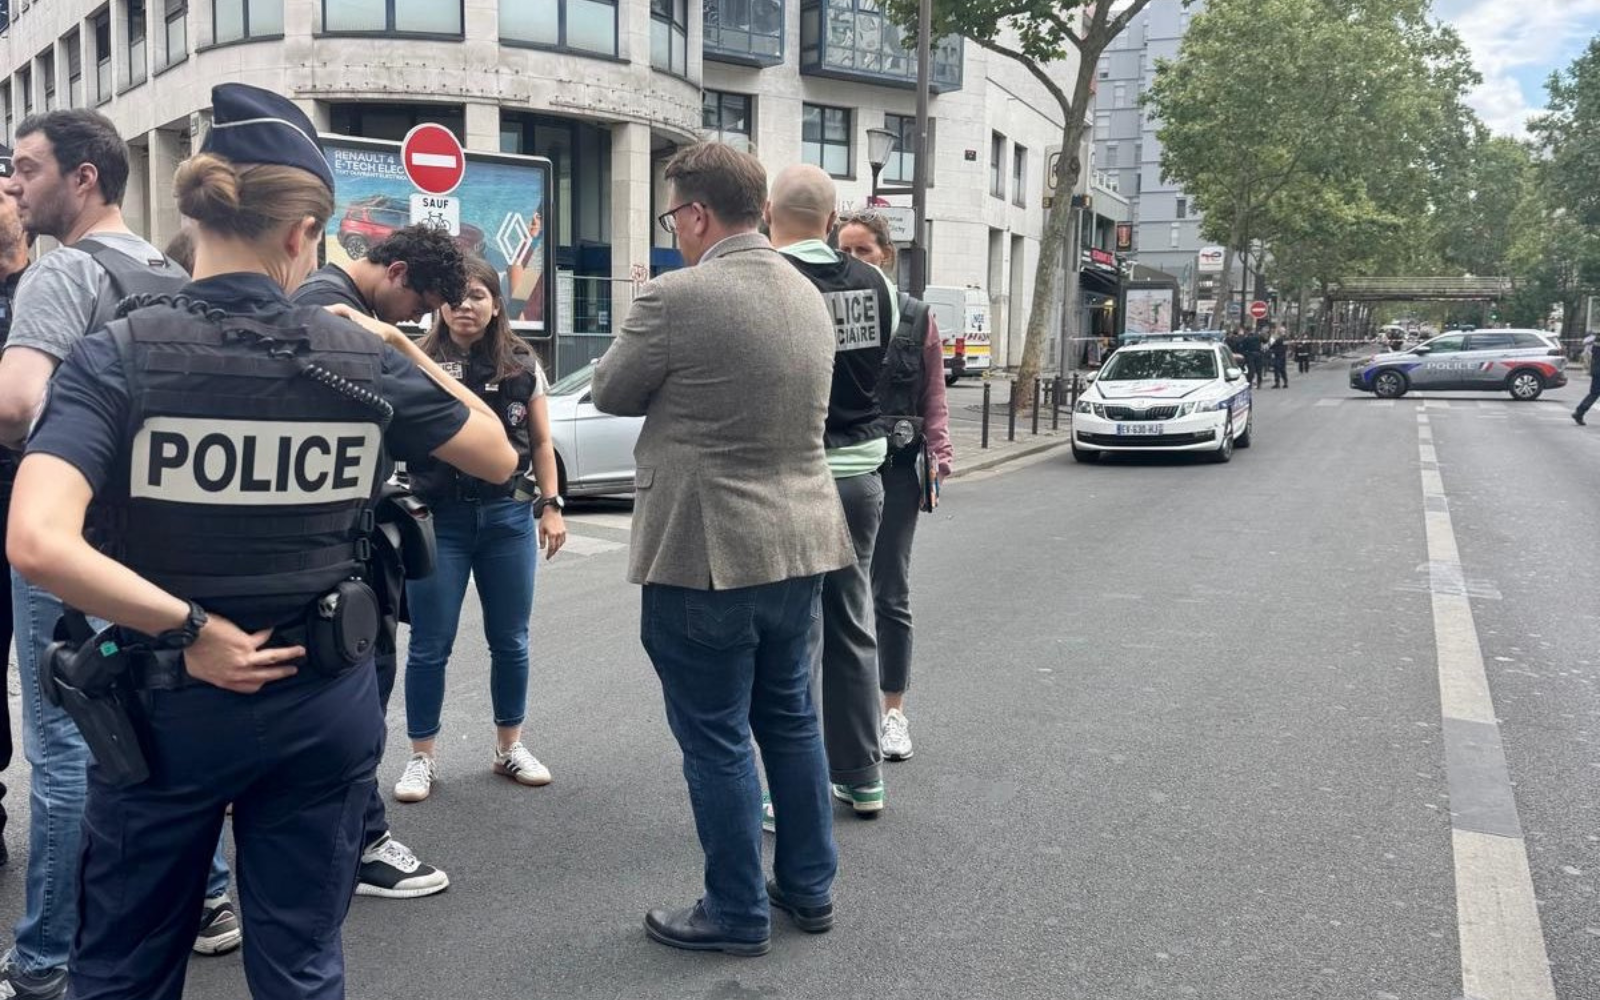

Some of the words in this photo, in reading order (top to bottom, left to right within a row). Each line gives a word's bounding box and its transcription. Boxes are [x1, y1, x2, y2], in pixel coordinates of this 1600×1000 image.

[335, 151, 386, 163] RENAULT
[387, 156, 395, 164] 4
[335, 160, 376, 173] E-TECH
[378, 164, 405, 174] ELEC
[422, 197, 449, 209] SAUF
[831, 296, 876, 325] LICE
[838, 325, 876, 345] CIAIRE
[1426, 361, 1475, 370] POLICE
[147, 430, 366, 493] POLICE
